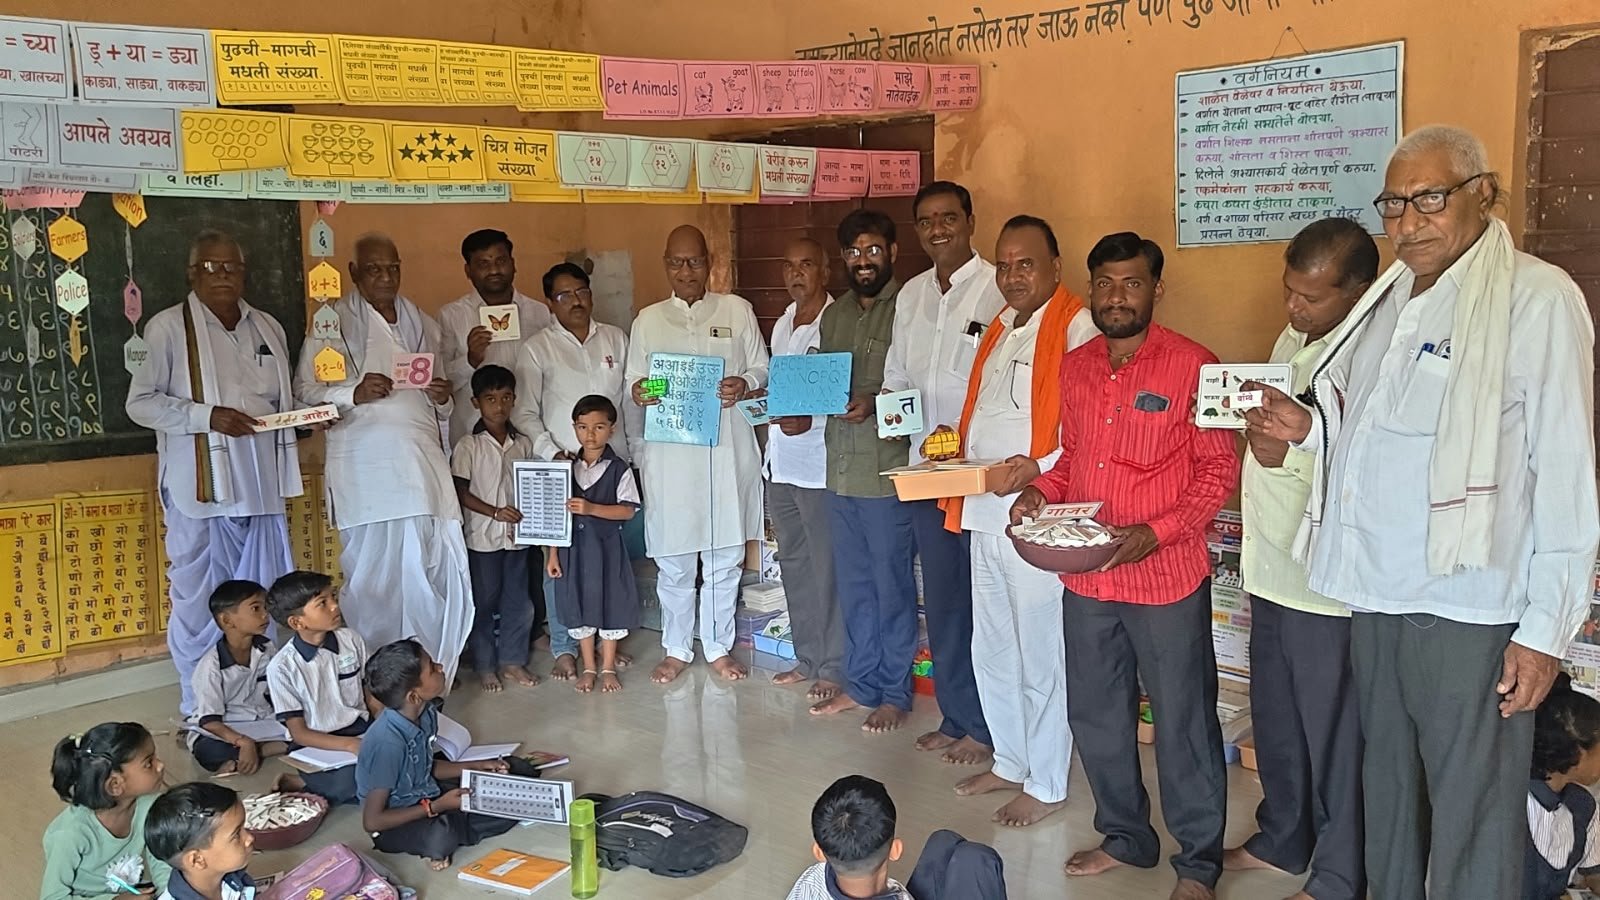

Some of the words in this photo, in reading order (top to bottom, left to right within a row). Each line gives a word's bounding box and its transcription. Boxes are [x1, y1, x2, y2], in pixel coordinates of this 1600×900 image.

[1006, 14, 1034, 48] तर
[1036, 7, 1080, 42] जाऊ
[229, 64, 270, 79] मधली
[693, 70, 707, 79] cat
[732, 68, 749, 77] goat
[762, 68, 782, 78] sheep
[788, 66, 814, 77] buffalo
[894, 68, 913, 86] माझे
[607, 77, 628, 95] Pet
[631, 79, 678, 97] Animals
[63, 117, 110, 144] आपले
[119, 127, 172, 148] अवयव
[483, 134, 508, 153] चित्र
[514, 137, 548, 162] मोजून
[497, 158, 536, 176] संख्या
[51, 230, 86, 247] Farmers
[57, 282, 87, 302] Police
[409, 357, 431, 385] 8
[898, 396, 916, 415] त
[36, 513, 52, 526] कार
[1047, 507, 1093, 516] गाजर
